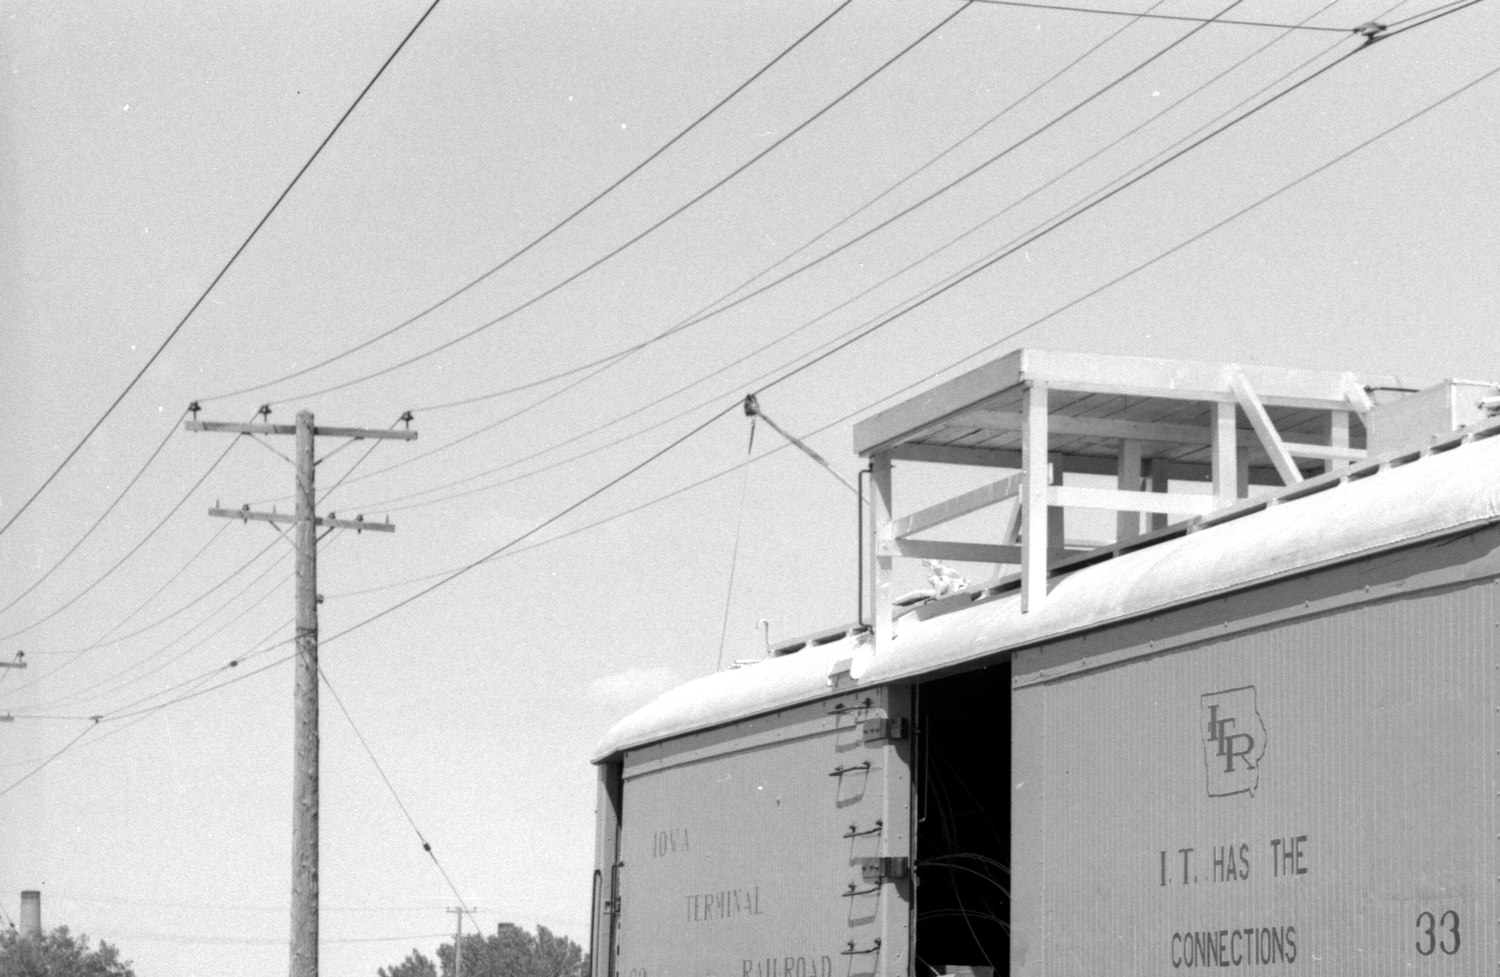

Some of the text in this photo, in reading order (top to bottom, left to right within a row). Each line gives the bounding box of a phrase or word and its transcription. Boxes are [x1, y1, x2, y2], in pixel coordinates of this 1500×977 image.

[1213, 843, 1250, 883] HAS
[1270, 834, 1309, 878] THE
[686, 886, 764, 922] TERMINAL
[1171, 925, 1298, 969] CONNECTIONS
[1415, 909, 1462, 956] 33
